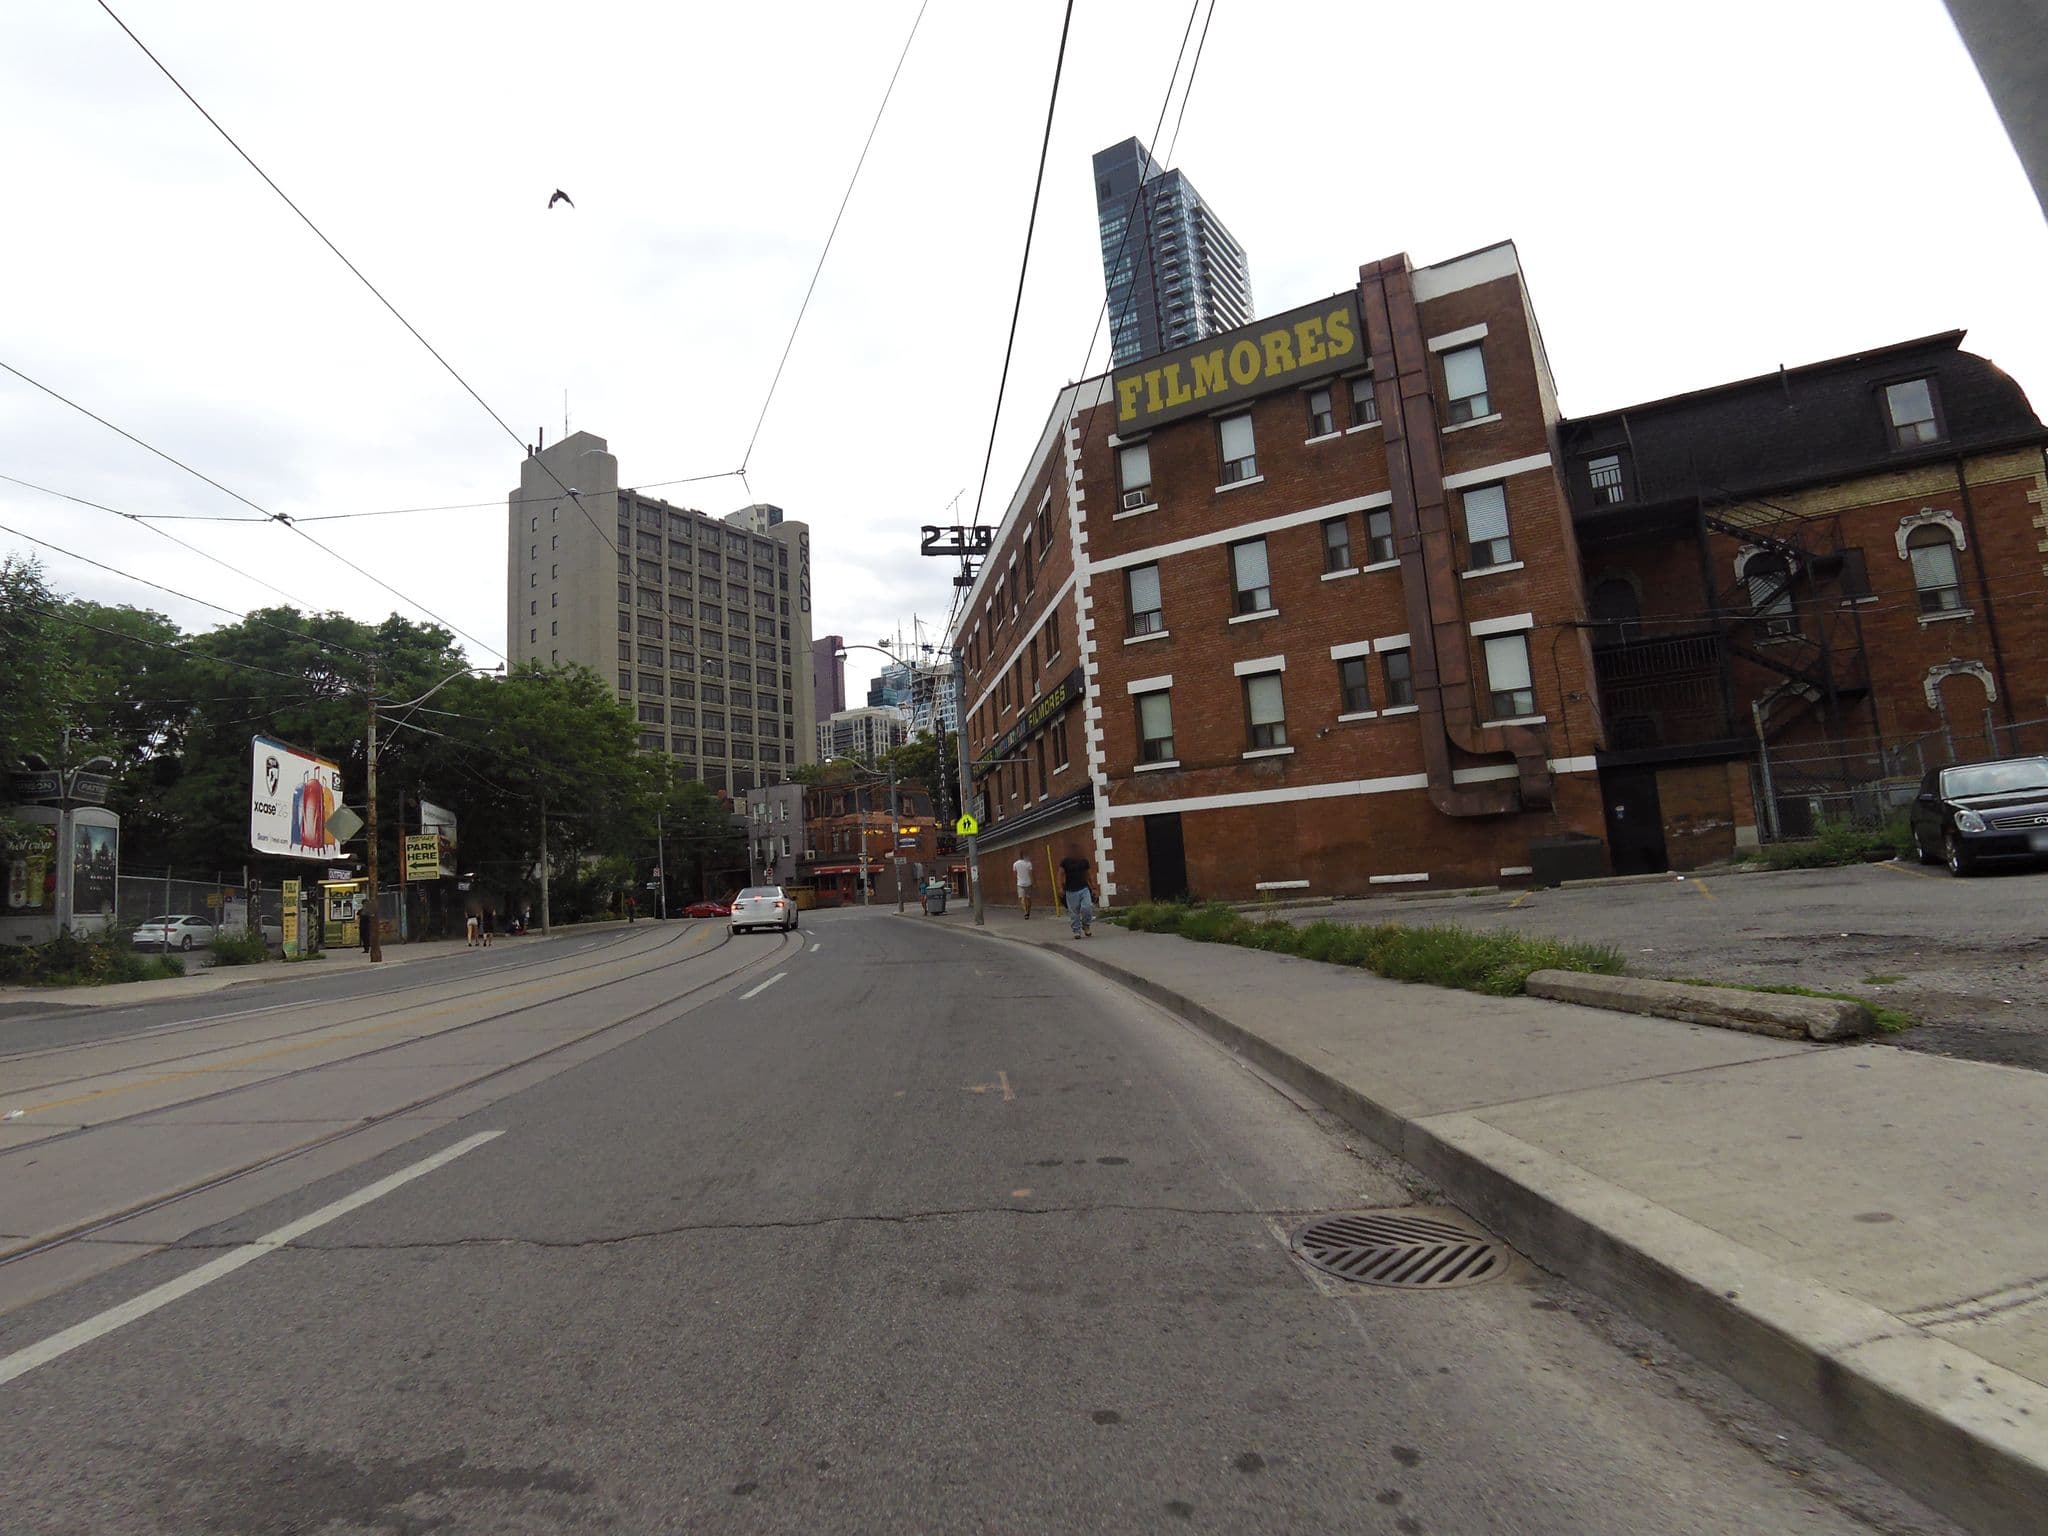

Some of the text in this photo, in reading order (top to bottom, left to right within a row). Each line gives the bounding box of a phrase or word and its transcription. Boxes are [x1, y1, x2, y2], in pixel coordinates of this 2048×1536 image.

[1117, 308, 1355, 422] FILMORES
[799, 531, 811, 613] GRAND
[1028, 684, 1067, 729] FILMORES
[407, 843, 436, 852] PARK
[407, 852, 438, 861] HERE
